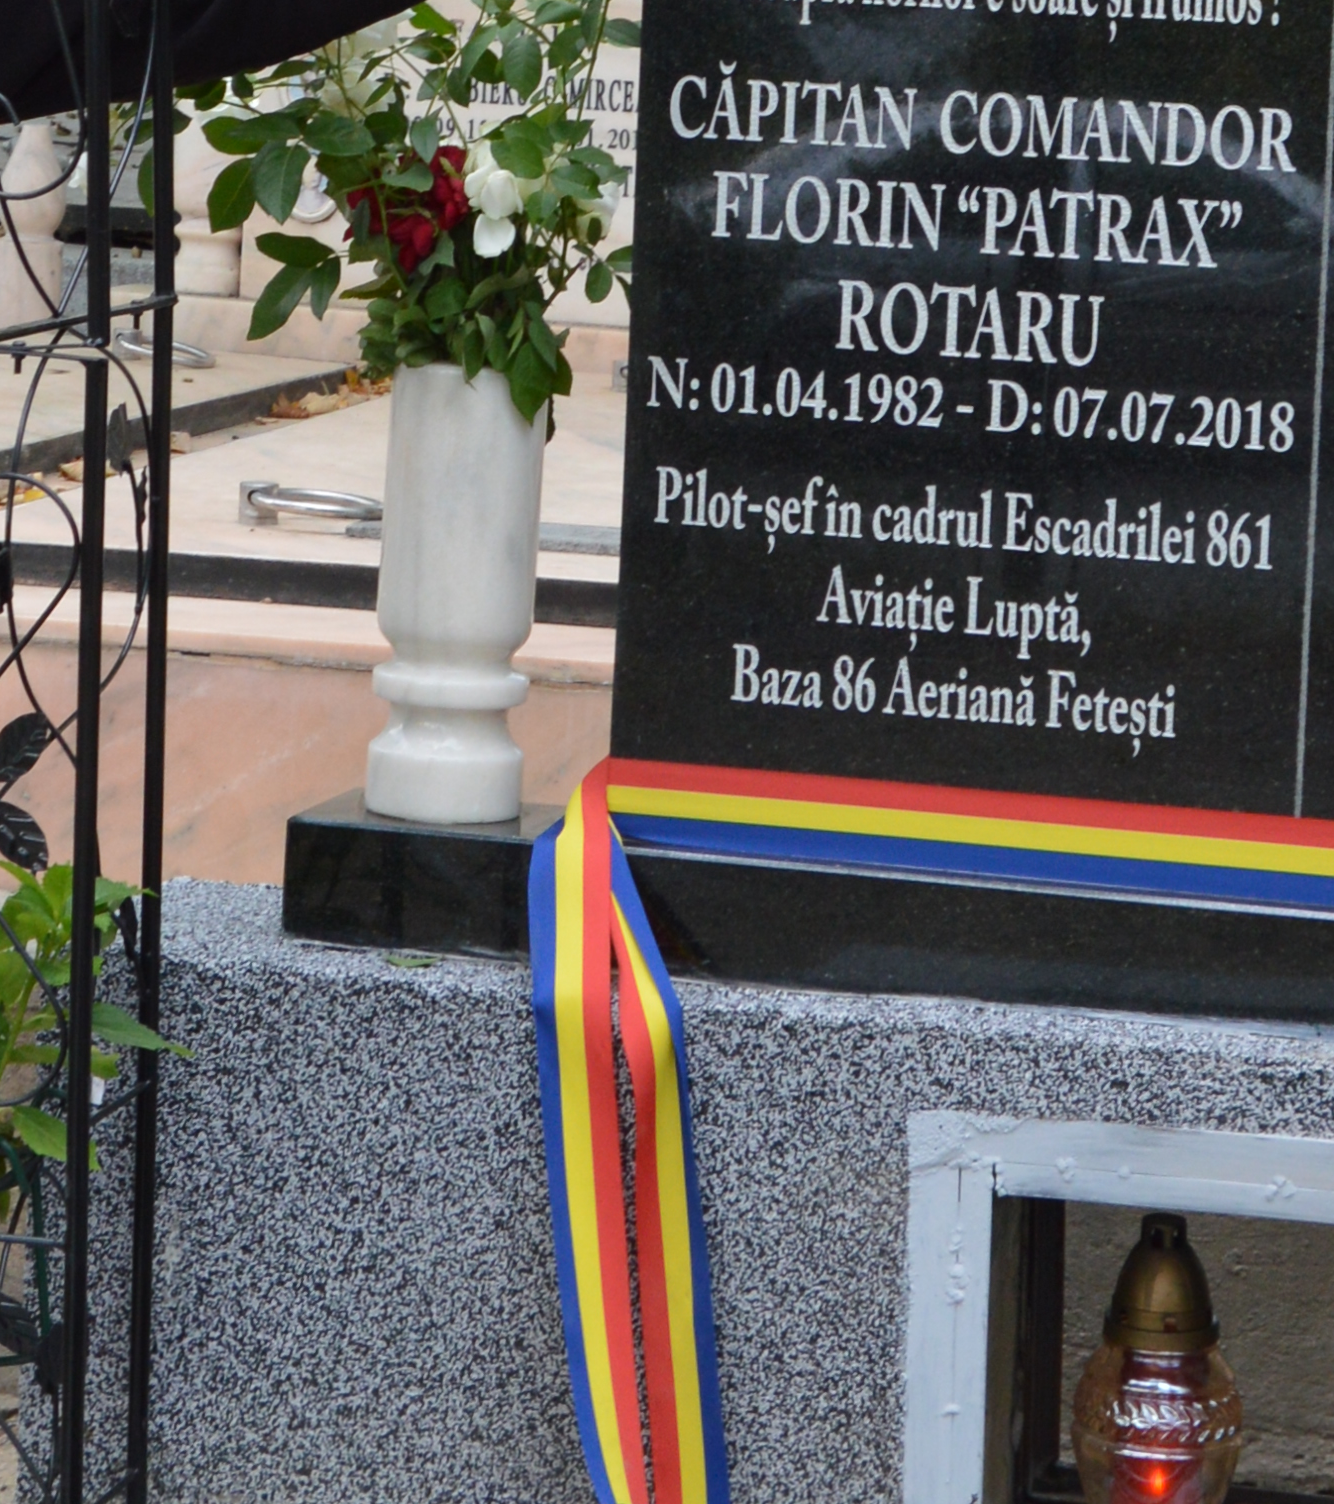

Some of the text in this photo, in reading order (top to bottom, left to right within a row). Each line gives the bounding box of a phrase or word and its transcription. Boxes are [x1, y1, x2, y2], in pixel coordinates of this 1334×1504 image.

[569, 77, 639, 114] MIRCE
[669, 60, 1297, 173] CĂPITAN COMANDOR
[711, 170, 947, 252] FLORIN
[835, 279, 1105, 367] ROTARU
[646, 355, 700, 411] N:
[710, 362, 944, 428] 01.04.1982
[985, 379, 1043, 435] D:
[1053, 386, 1295, 453] 07.07.2018
[653, 466, 1273, 570] Pilot-șef în cadrul Escadrilei 861
[816, 564, 1091, 660] Aviație Luptă,
[730, 643, 1176, 757] Baza 86 Aeriană Fetești
